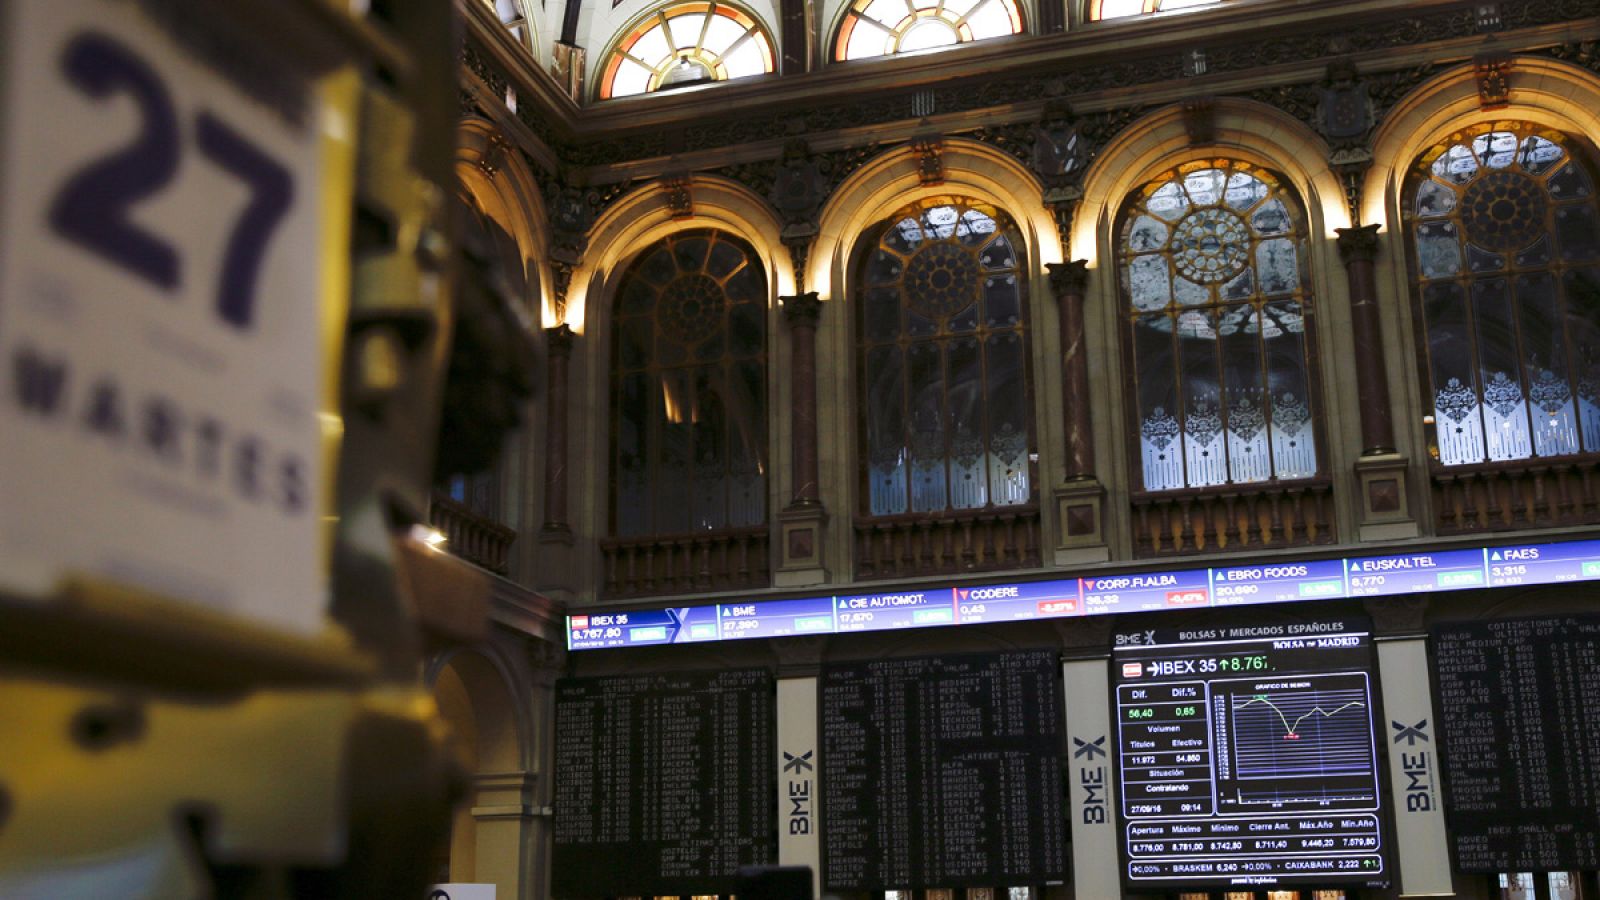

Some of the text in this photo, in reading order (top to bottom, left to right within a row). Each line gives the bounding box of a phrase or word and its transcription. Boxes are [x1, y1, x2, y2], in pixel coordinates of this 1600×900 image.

[47, 30, 296, 331] 27
[1503, 548, 1540, 561] FAES
[1363, 556, 1437, 572] EUSKALTEL
[1227, 566, 1308, 580] EBRO FOODS
[970, 587, 1019, 600] CODERE
[849, 594, 927, 608] CIE AUTOMOT.
[733, 606, 756, 616] BME
[591, 614, 628, 626] IBEX 35
[1180, 630, 1216, 640] BOLSAS
[1220, 629, 1226, 638] Y
[1230, 625, 1284, 638] MERCADOS
[1288, 622, 1344, 634] ESPAÑOLES
[1317, 636, 1360, 648] MADRID
[1159, 659, 1196, 676] IBEX
[1199, 658, 1217, 672] 35
[1132, 690, 1148, 699] Dif.
[1147, 725, 1181, 733] Volumen
[1146, 784, 1190, 793] Contratando
[1131, 826, 1164, 836] Apertura
[1248, 823, 1273, 832] Cierre
[1172, 864, 1213, 872] BRASKEM
[1284, 860, 1334, 870] CAIXABANK
